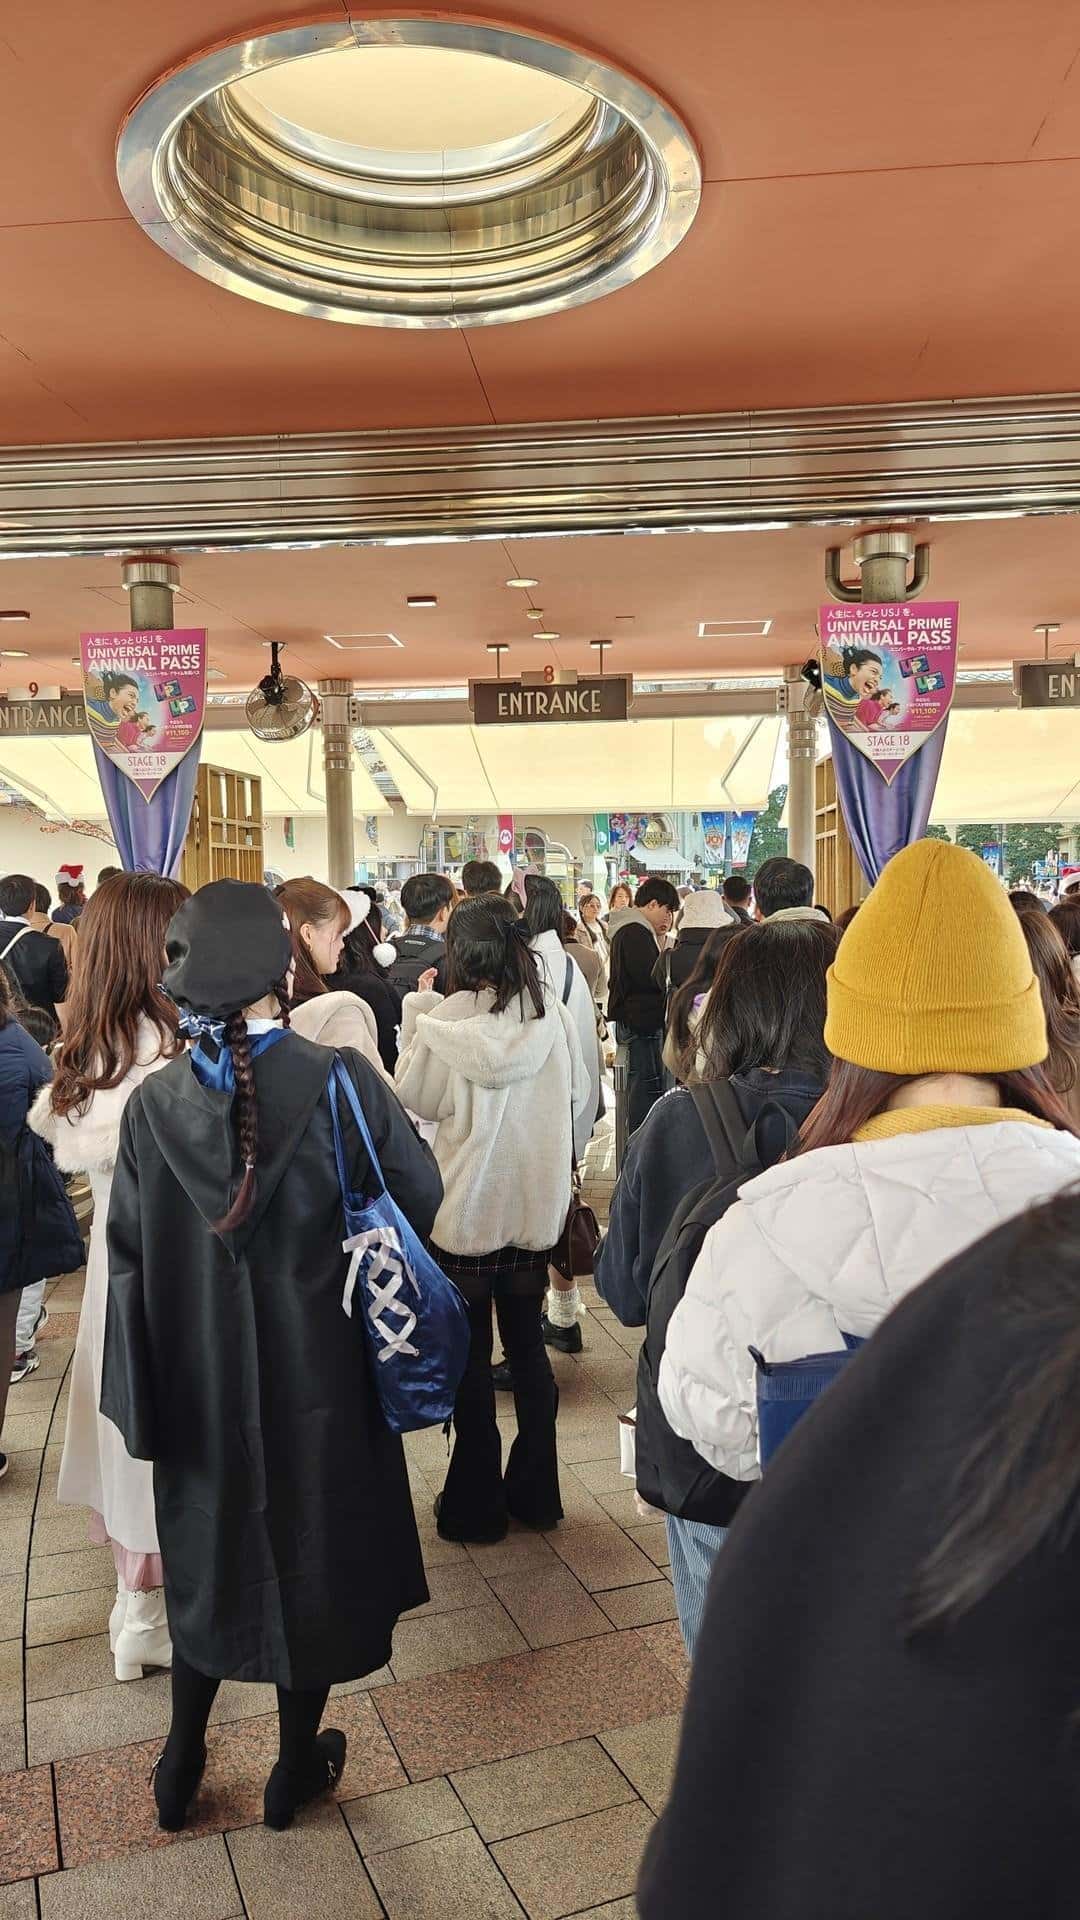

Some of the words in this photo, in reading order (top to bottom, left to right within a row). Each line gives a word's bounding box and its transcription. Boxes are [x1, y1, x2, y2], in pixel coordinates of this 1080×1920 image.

[827, 619, 905, 632] UNIVERSAL
[908, 617, 952, 630] PRIME
[827, 631, 903, 647] ANNUAL
[907, 630, 952, 645] PASS
[87, 646, 158, 658] UNIVERSAL
[160, 644, 200, 655] PRIME
[88, 657, 156, 672] ANNUAL
[160, 656, 200, 670] PASS
[543, 665, 554, 683] 8
[28, 682, 38, 698] 9
[498, 690, 601, 716] ENTRANCE
[0, 705, 84, 728] NTRANCE
[867, 736, 895, 746] STAGE
[899, 735, 910, 746] 18
[128, 755, 152, 767] STAGE
[156, 755, 167, 766] 18
